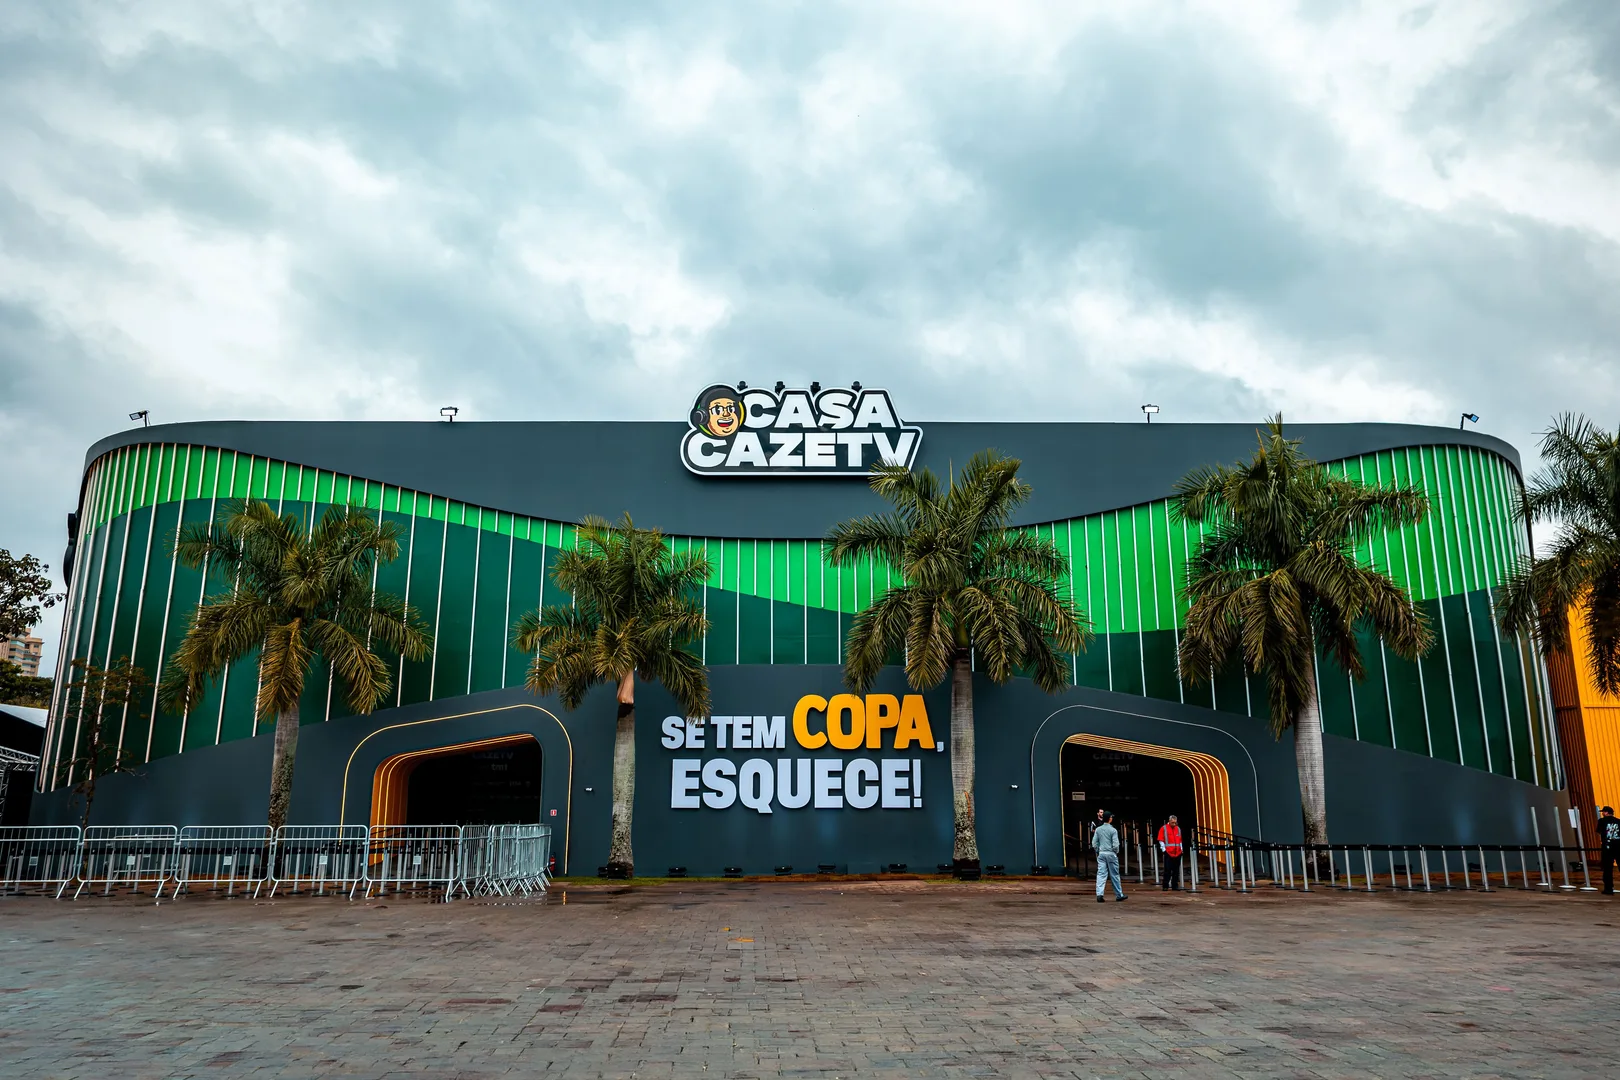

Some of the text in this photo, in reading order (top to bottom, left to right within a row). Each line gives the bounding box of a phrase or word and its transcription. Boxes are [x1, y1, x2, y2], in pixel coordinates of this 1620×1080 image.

[742, 393, 896, 429] CASA
[687, 432, 915, 467] CAZETV
[661, 693, 944, 752] SE TEM COPA,
[671, 758, 922, 814] ESQUECE!
